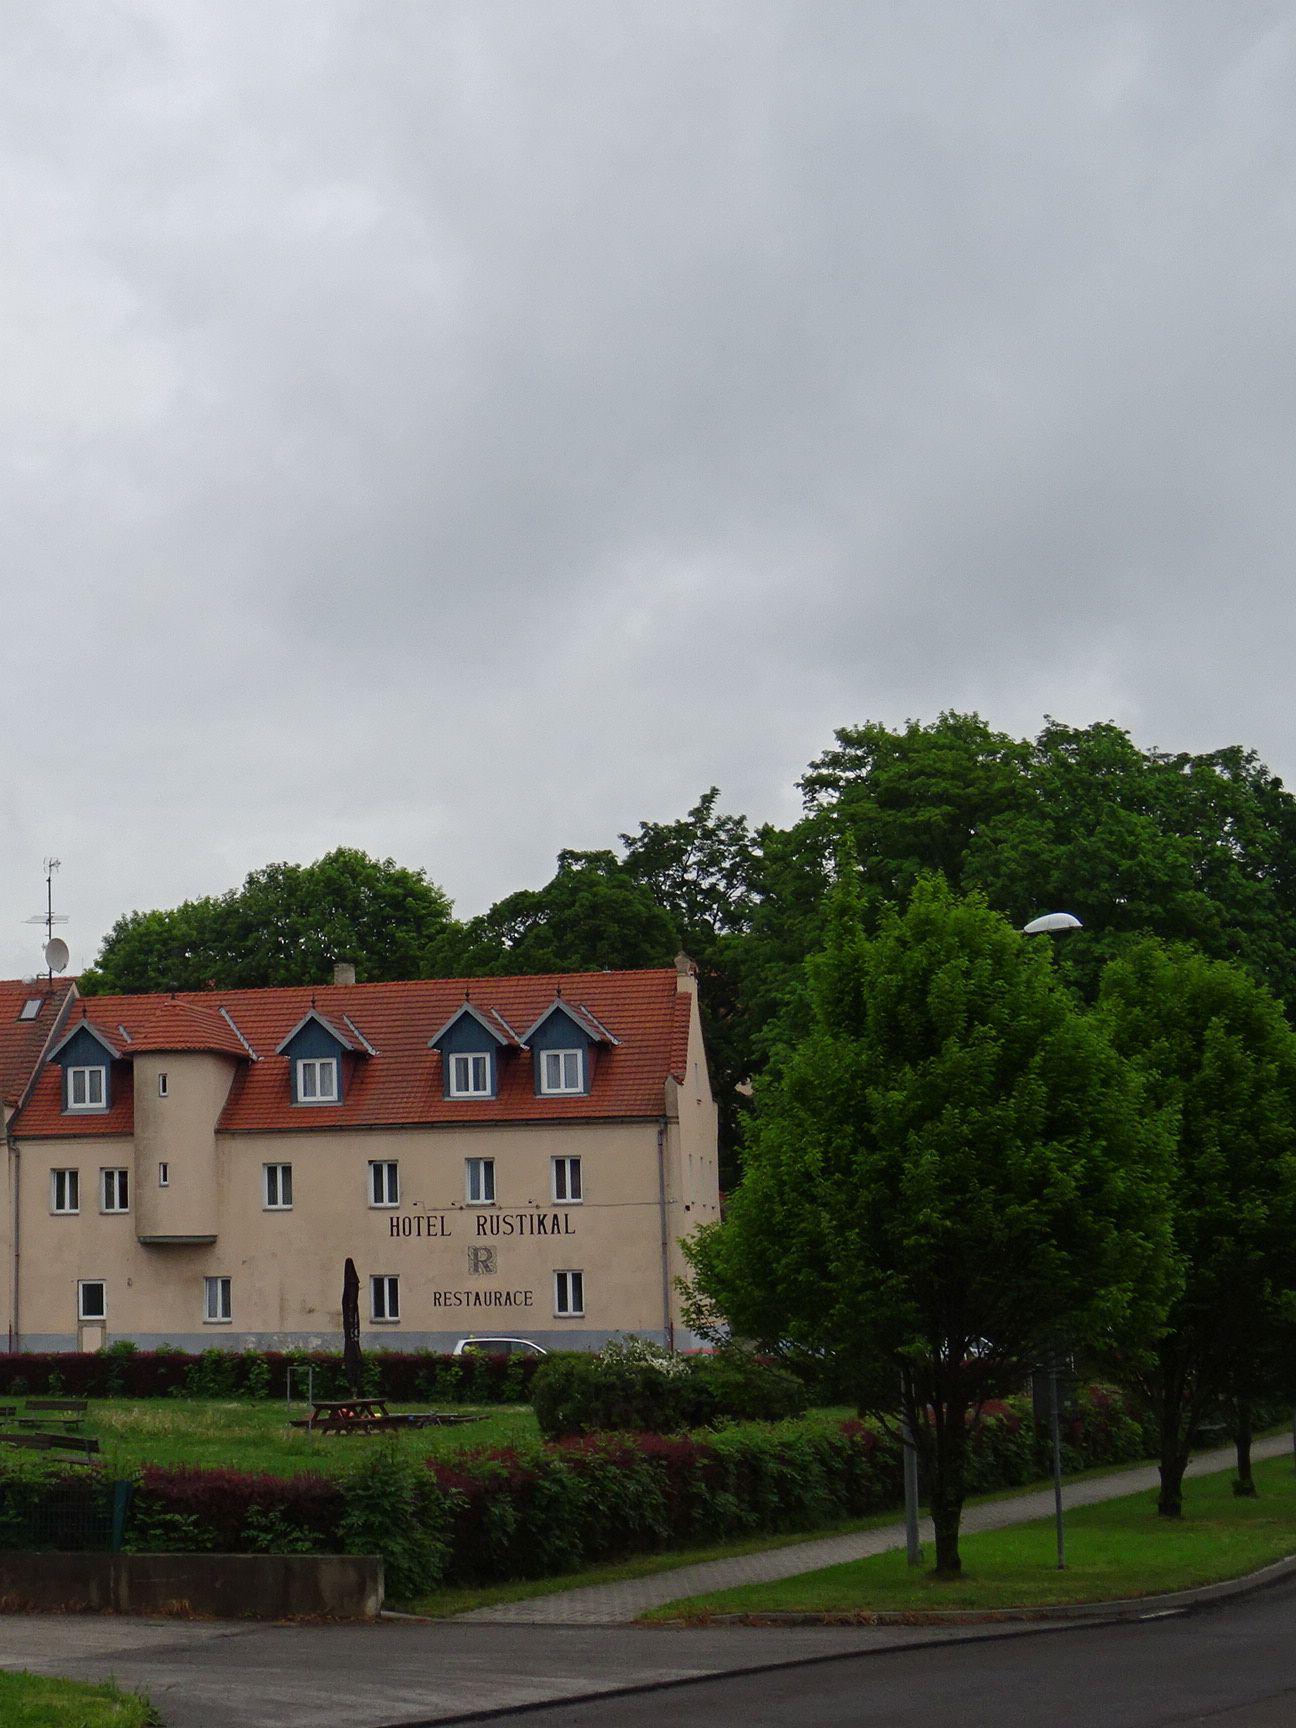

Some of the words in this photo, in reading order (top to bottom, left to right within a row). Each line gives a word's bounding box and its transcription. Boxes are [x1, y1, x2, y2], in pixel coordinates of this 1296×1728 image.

[389, 1216, 452, 1237] HOTEL
[476, 1213, 576, 1236] RUSTIKAL
[471, 1246, 494, 1274] R
[433, 1290, 533, 1307] RESTAURACE
